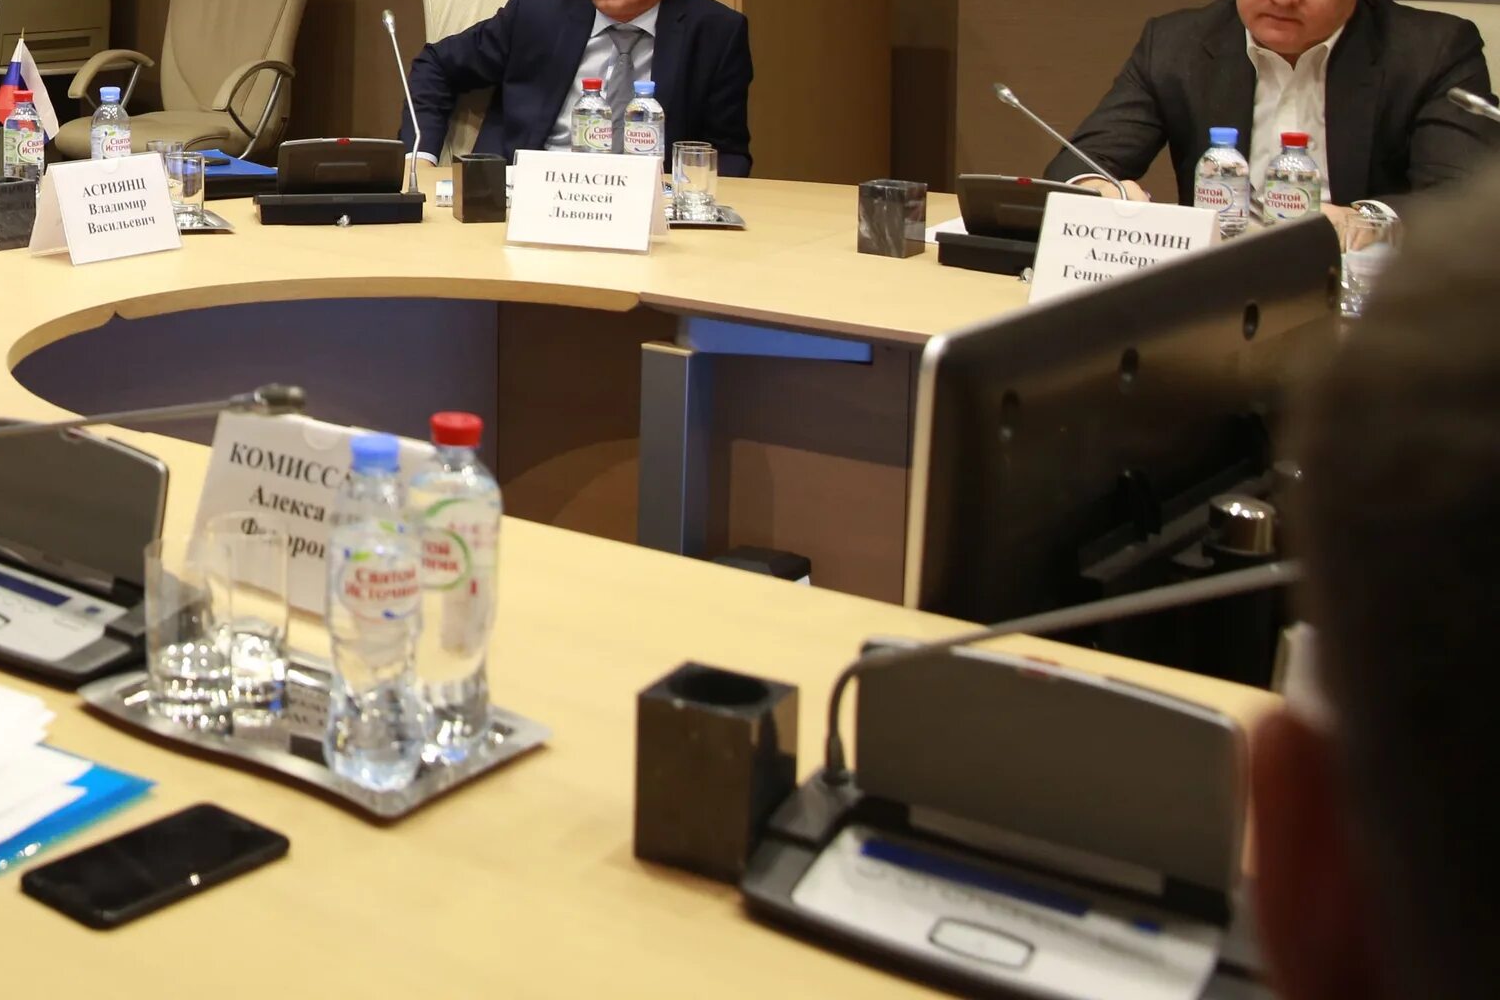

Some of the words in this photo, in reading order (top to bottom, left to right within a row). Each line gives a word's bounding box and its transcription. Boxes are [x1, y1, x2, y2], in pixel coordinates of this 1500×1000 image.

[544, 170, 628, 187] ПАНАСИК
[81, 177, 148, 199] АСРИЯНЦ
[553, 188, 613, 204] Алексей
[88, 198, 147, 216] Владимир
[548, 206, 613, 222] Львович
[86, 214, 156, 235] Васильевич
[1062, 222, 1191, 251] КОСТРОМИН
